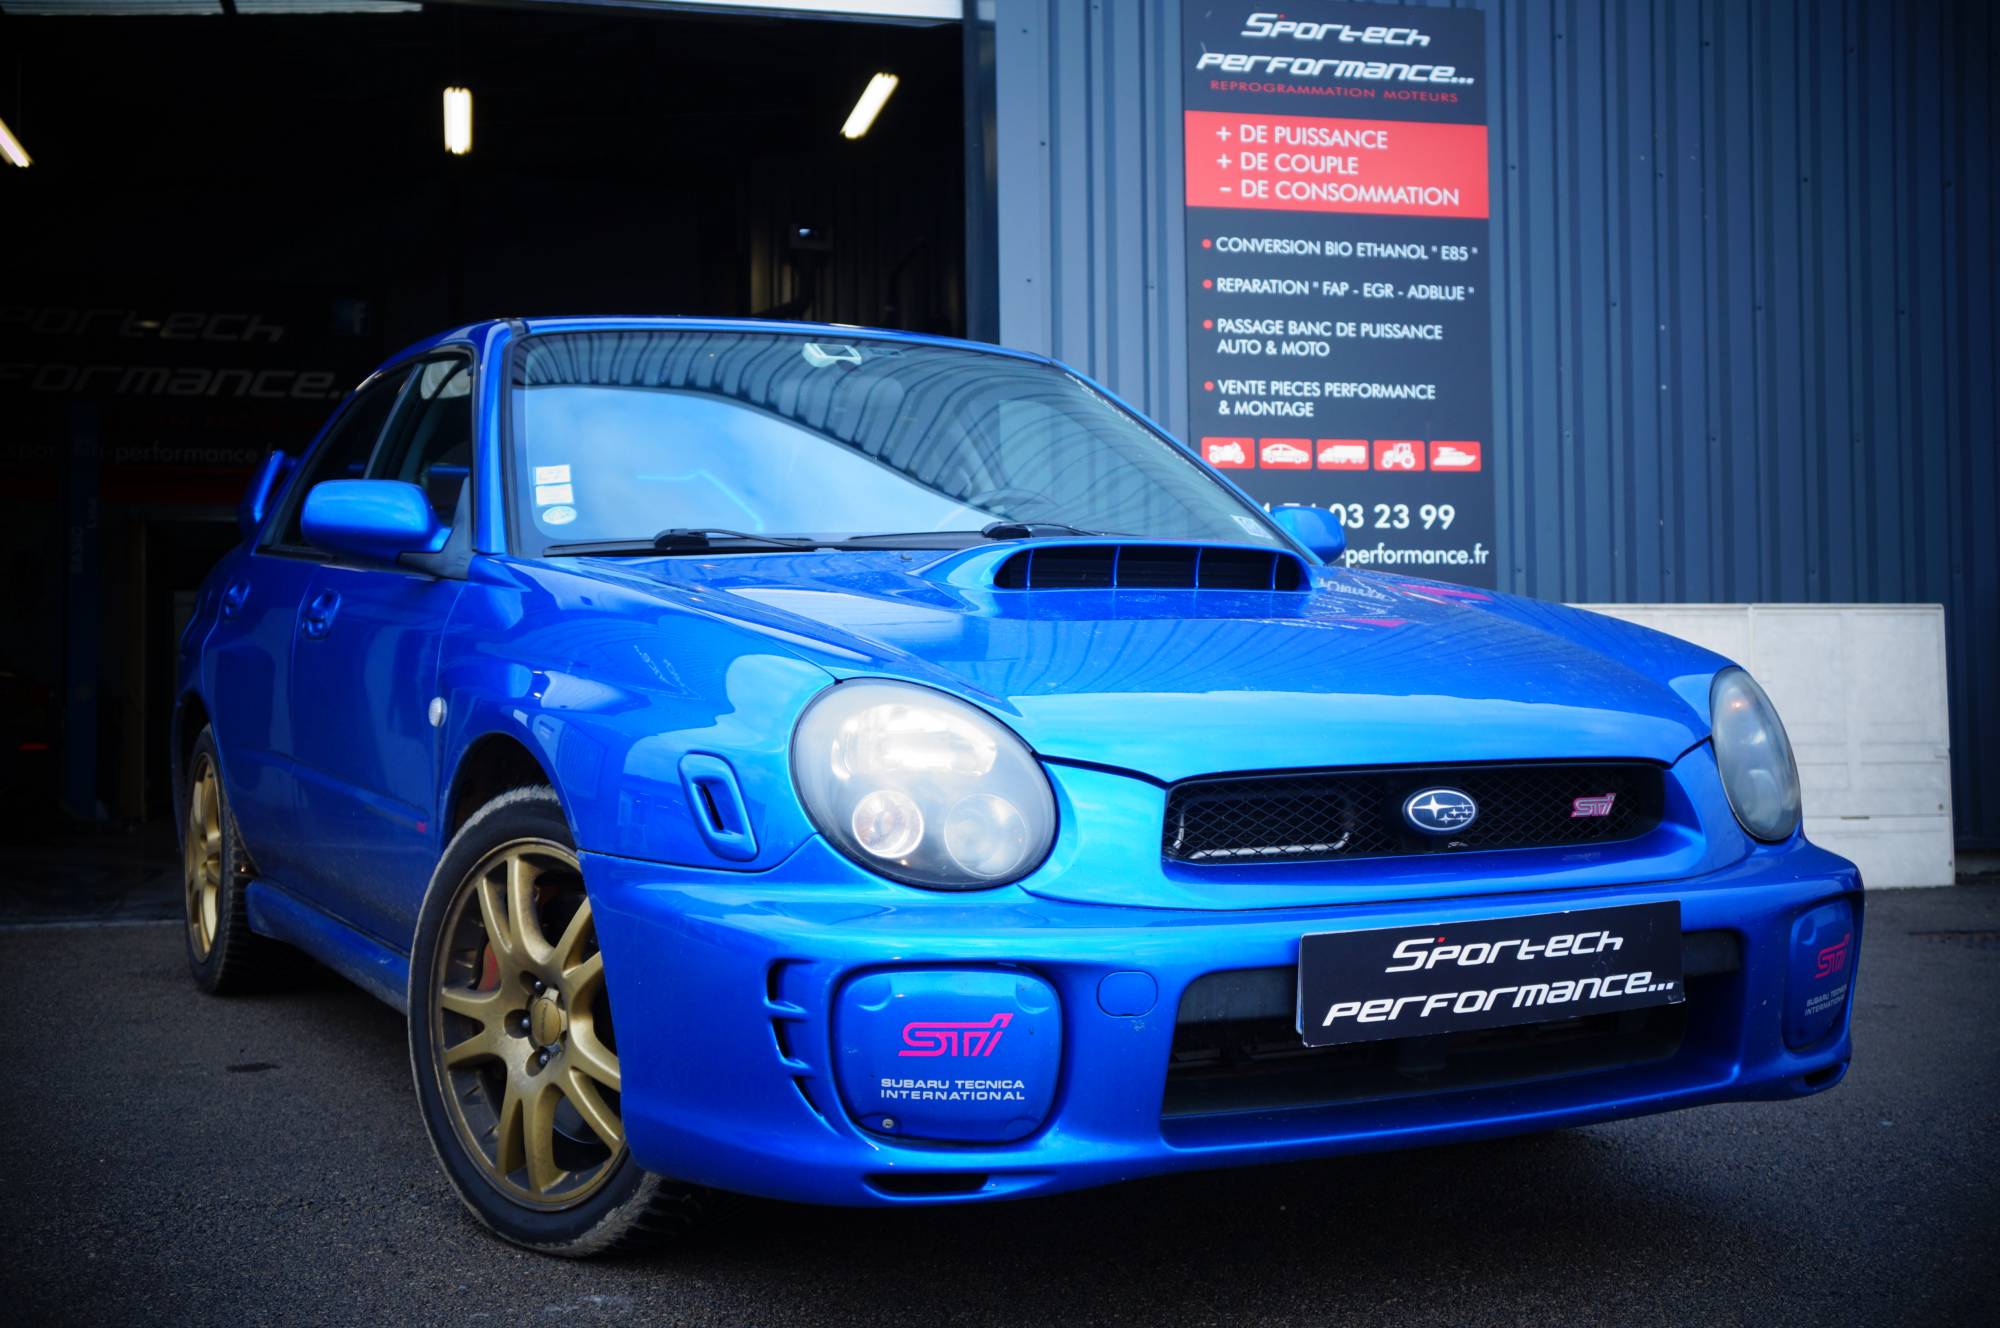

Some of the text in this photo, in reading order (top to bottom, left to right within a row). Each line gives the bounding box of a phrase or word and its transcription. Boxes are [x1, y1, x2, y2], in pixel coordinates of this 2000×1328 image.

[1210, 79, 1458, 103] REPROGRAMMATION MOTEURS
[1240, 124, 1268, 143] DE
[1274, 126, 1388, 149] PUISSANCE
[1240, 152, 1268, 171] DE
[1274, 153, 1359, 175] COUPLE
[1240, 180, 1269, 199] DE
[1275, 181, 1459, 206] CONSOMMATION
[1215, 236, 1321, 256] CONVERSION
[1325, 241, 1352, 257] BIO
[1356, 242, 1429, 260] ETHANOL
[1441, 246, 1469, 261] E85
[1216, 277, 1309, 296] REPARATION
[1323, 281, 1349, 296] FAP
[1363, 283, 1394, 298] EGR
[1407, 284, 1465, 300] ADBLUE
[1217, 318, 1443, 340] PASSAGE BANC DE PUISSANCE
[1217, 339, 1330, 357] AUTO & MOTO
[1218, 379, 1436, 400] VENTE PIECES PERFORMANCE
[1218, 401, 1314, 417] & MONTAGE
[1374, 504, 1410, 529] 23
[1419, 504, 1456, 530] 99
[880, 1089, 1025, 1101] INTERNATIONAL
[881, 1078, 1025, 1089] SUBARU TECNICA
